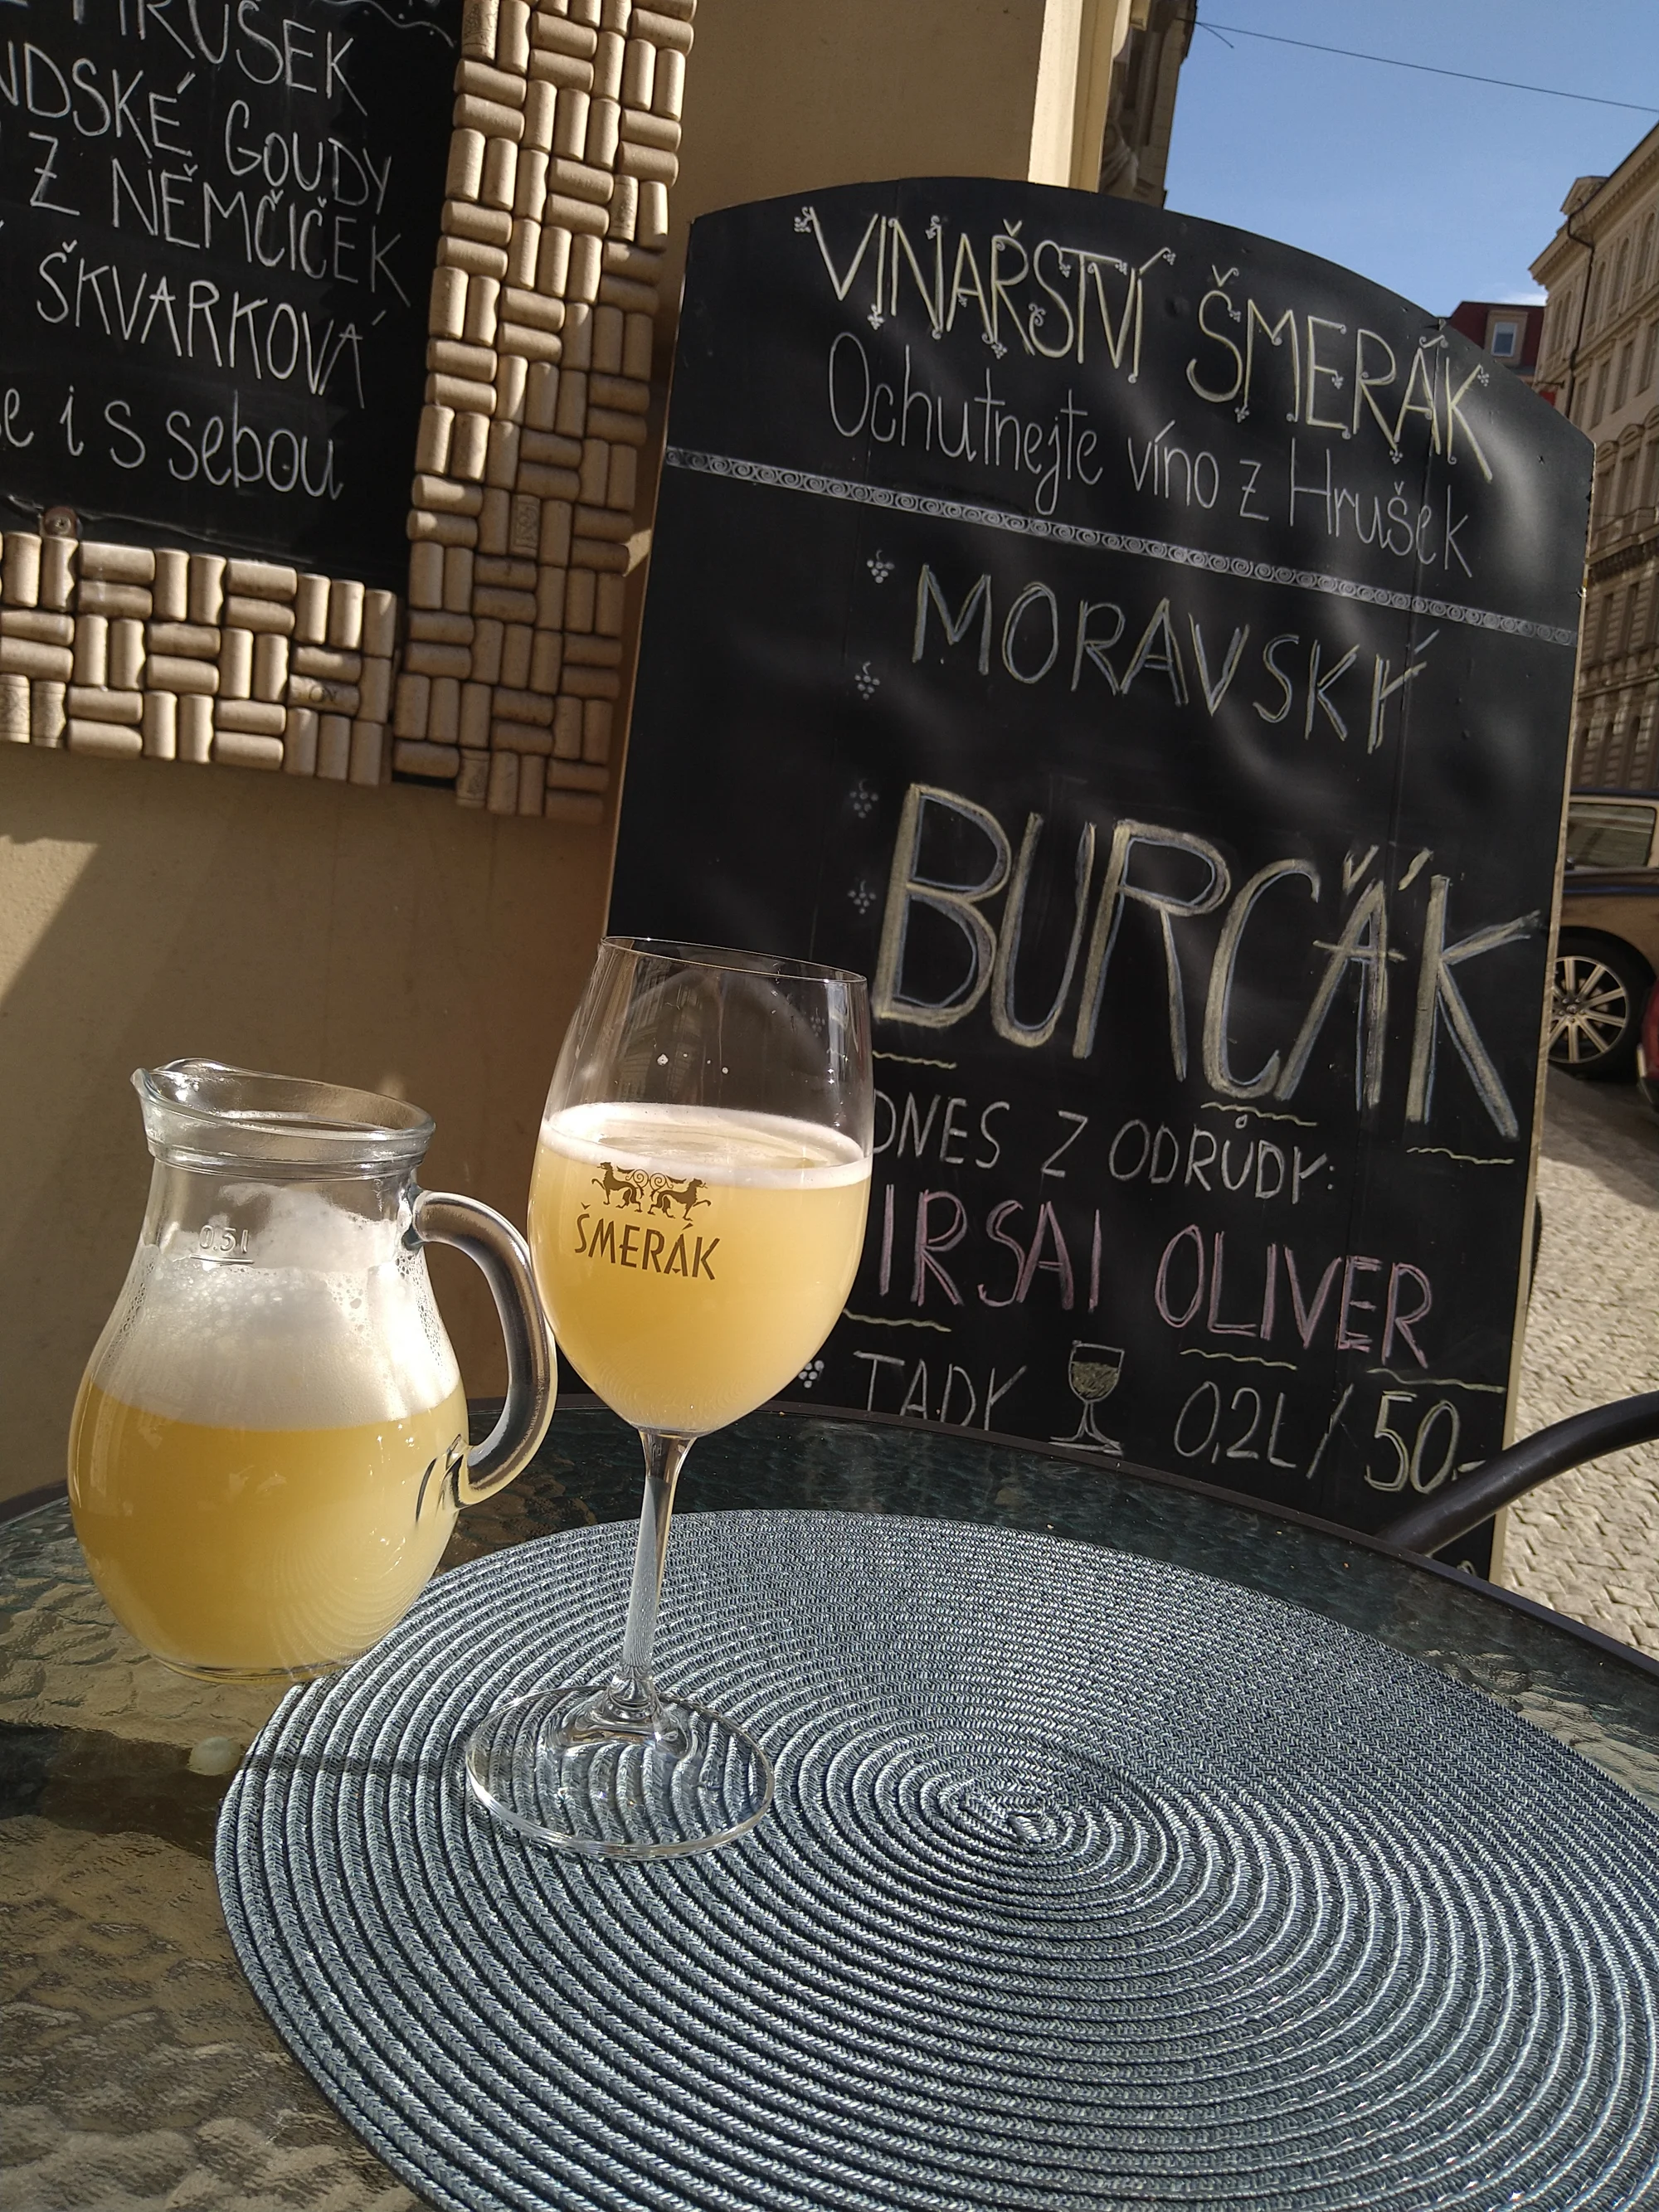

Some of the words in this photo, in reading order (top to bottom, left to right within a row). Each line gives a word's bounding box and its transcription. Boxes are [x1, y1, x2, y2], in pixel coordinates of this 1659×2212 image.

[28, 131, 80, 216] Z
[112, 157, 411, 308] NĚMČIČEK
[225, 99, 392, 214] GOUDY
[36, 239, 387, 409] ŠKVARKOVÁ
[794, 206, 1175, 383] VINAŘSTVÍ
[1186, 264, 1493, 483] ŠMERÁK
[59, 386, 84, 457] i
[166, 389, 344, 500] sebou
[830, 333, 1103, 515] Ochutnejte
[1127, 420, 1219, 509] víno
[1289, 437, 1472, 577] Hrušek
[912, 564, 1440, 755] MORAVSKÝ
[873, 783, 1541, 1140] BURČÁK
[873, 1087, 1010, 1169] DNES
[1041, 1110, 1088, 1177] Z
[1108, 1114, 1336, 1204] ODRŮDY:
[574, 1202, 721, 1281] ŠMERÁK
[878, 1184, 1104, 1314] IRSAI
[1154, 1223, 1433, 1369] OLIVER
[854, 1350, 1027, 1431] TADY
